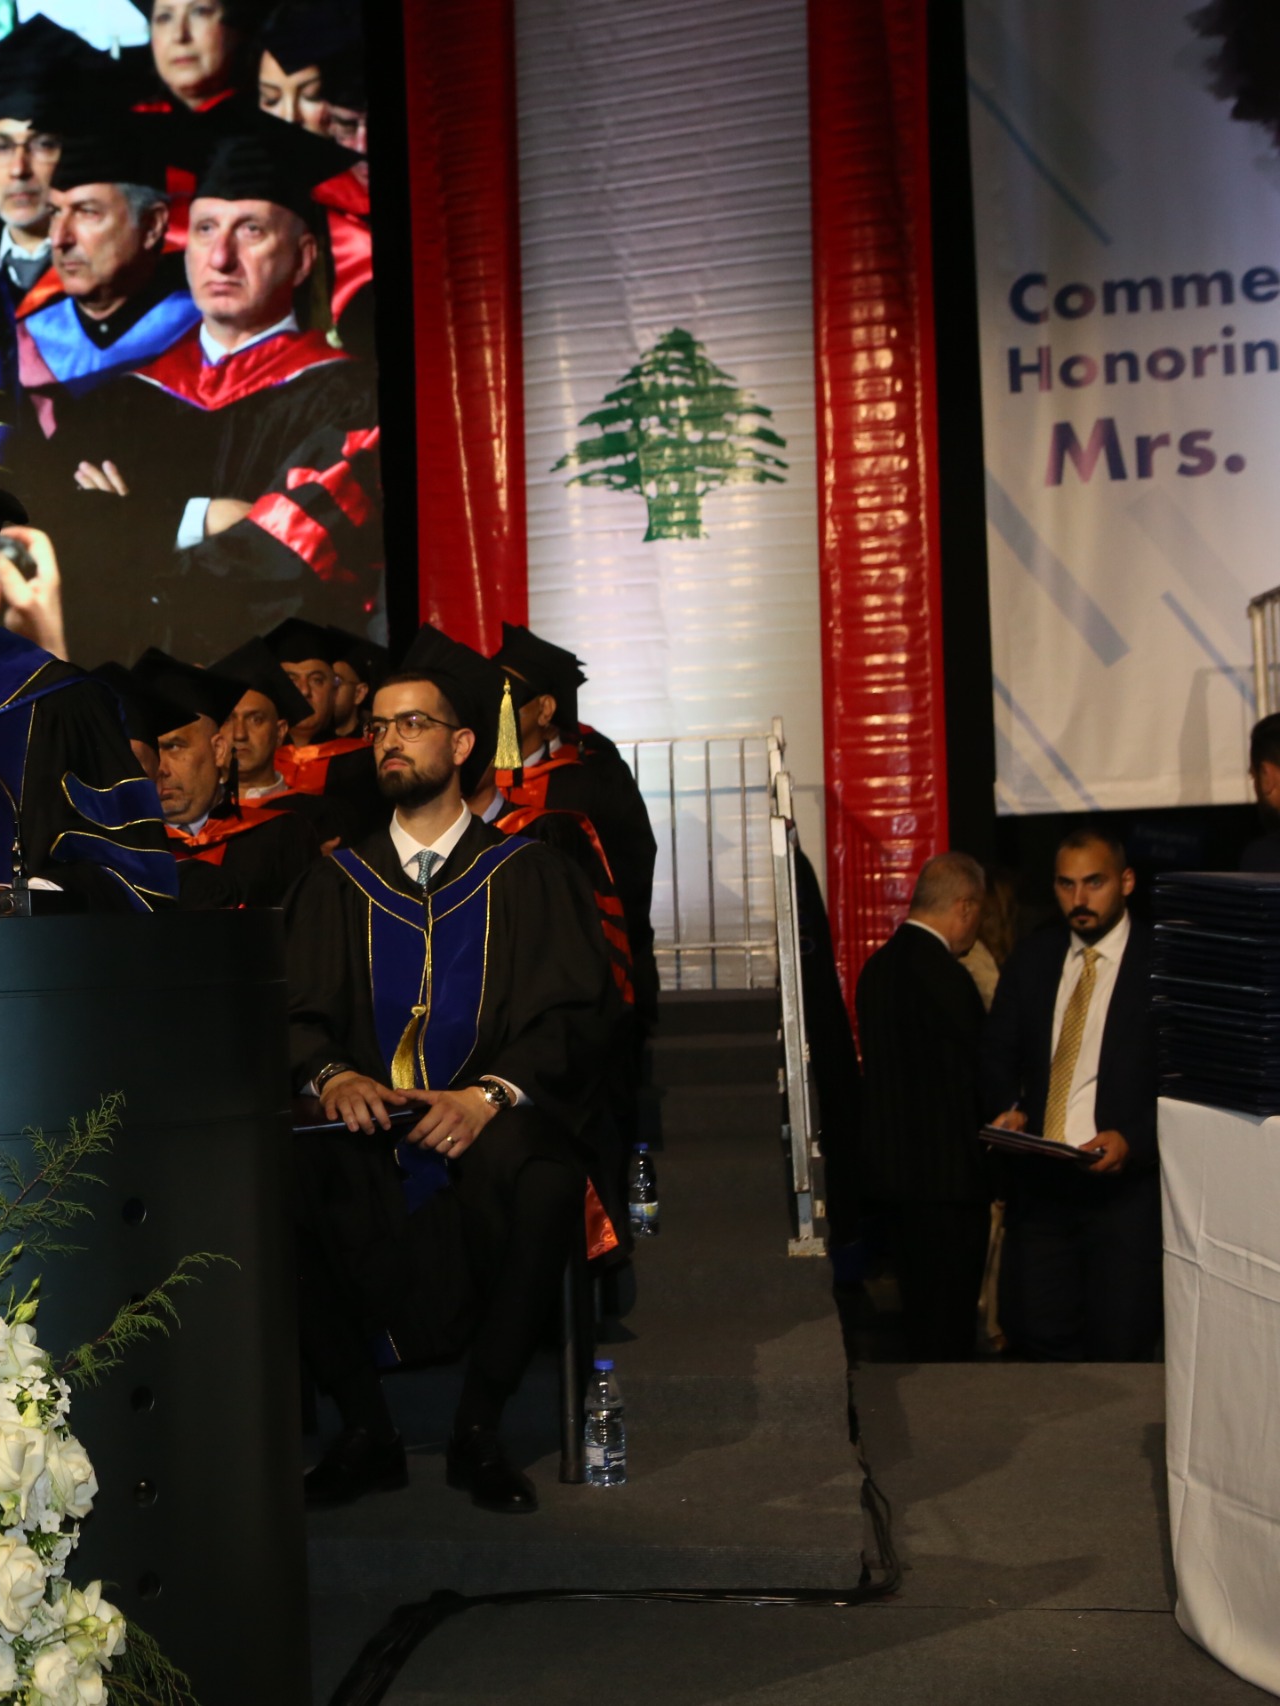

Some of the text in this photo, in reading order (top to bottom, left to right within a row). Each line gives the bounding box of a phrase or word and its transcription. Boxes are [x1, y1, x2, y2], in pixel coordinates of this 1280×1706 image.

[1008, 265, 1280, 325] Comme
[1007, 323, 1280, 394] Honorin
[1044, 416, 1246, 487] Mrs.
